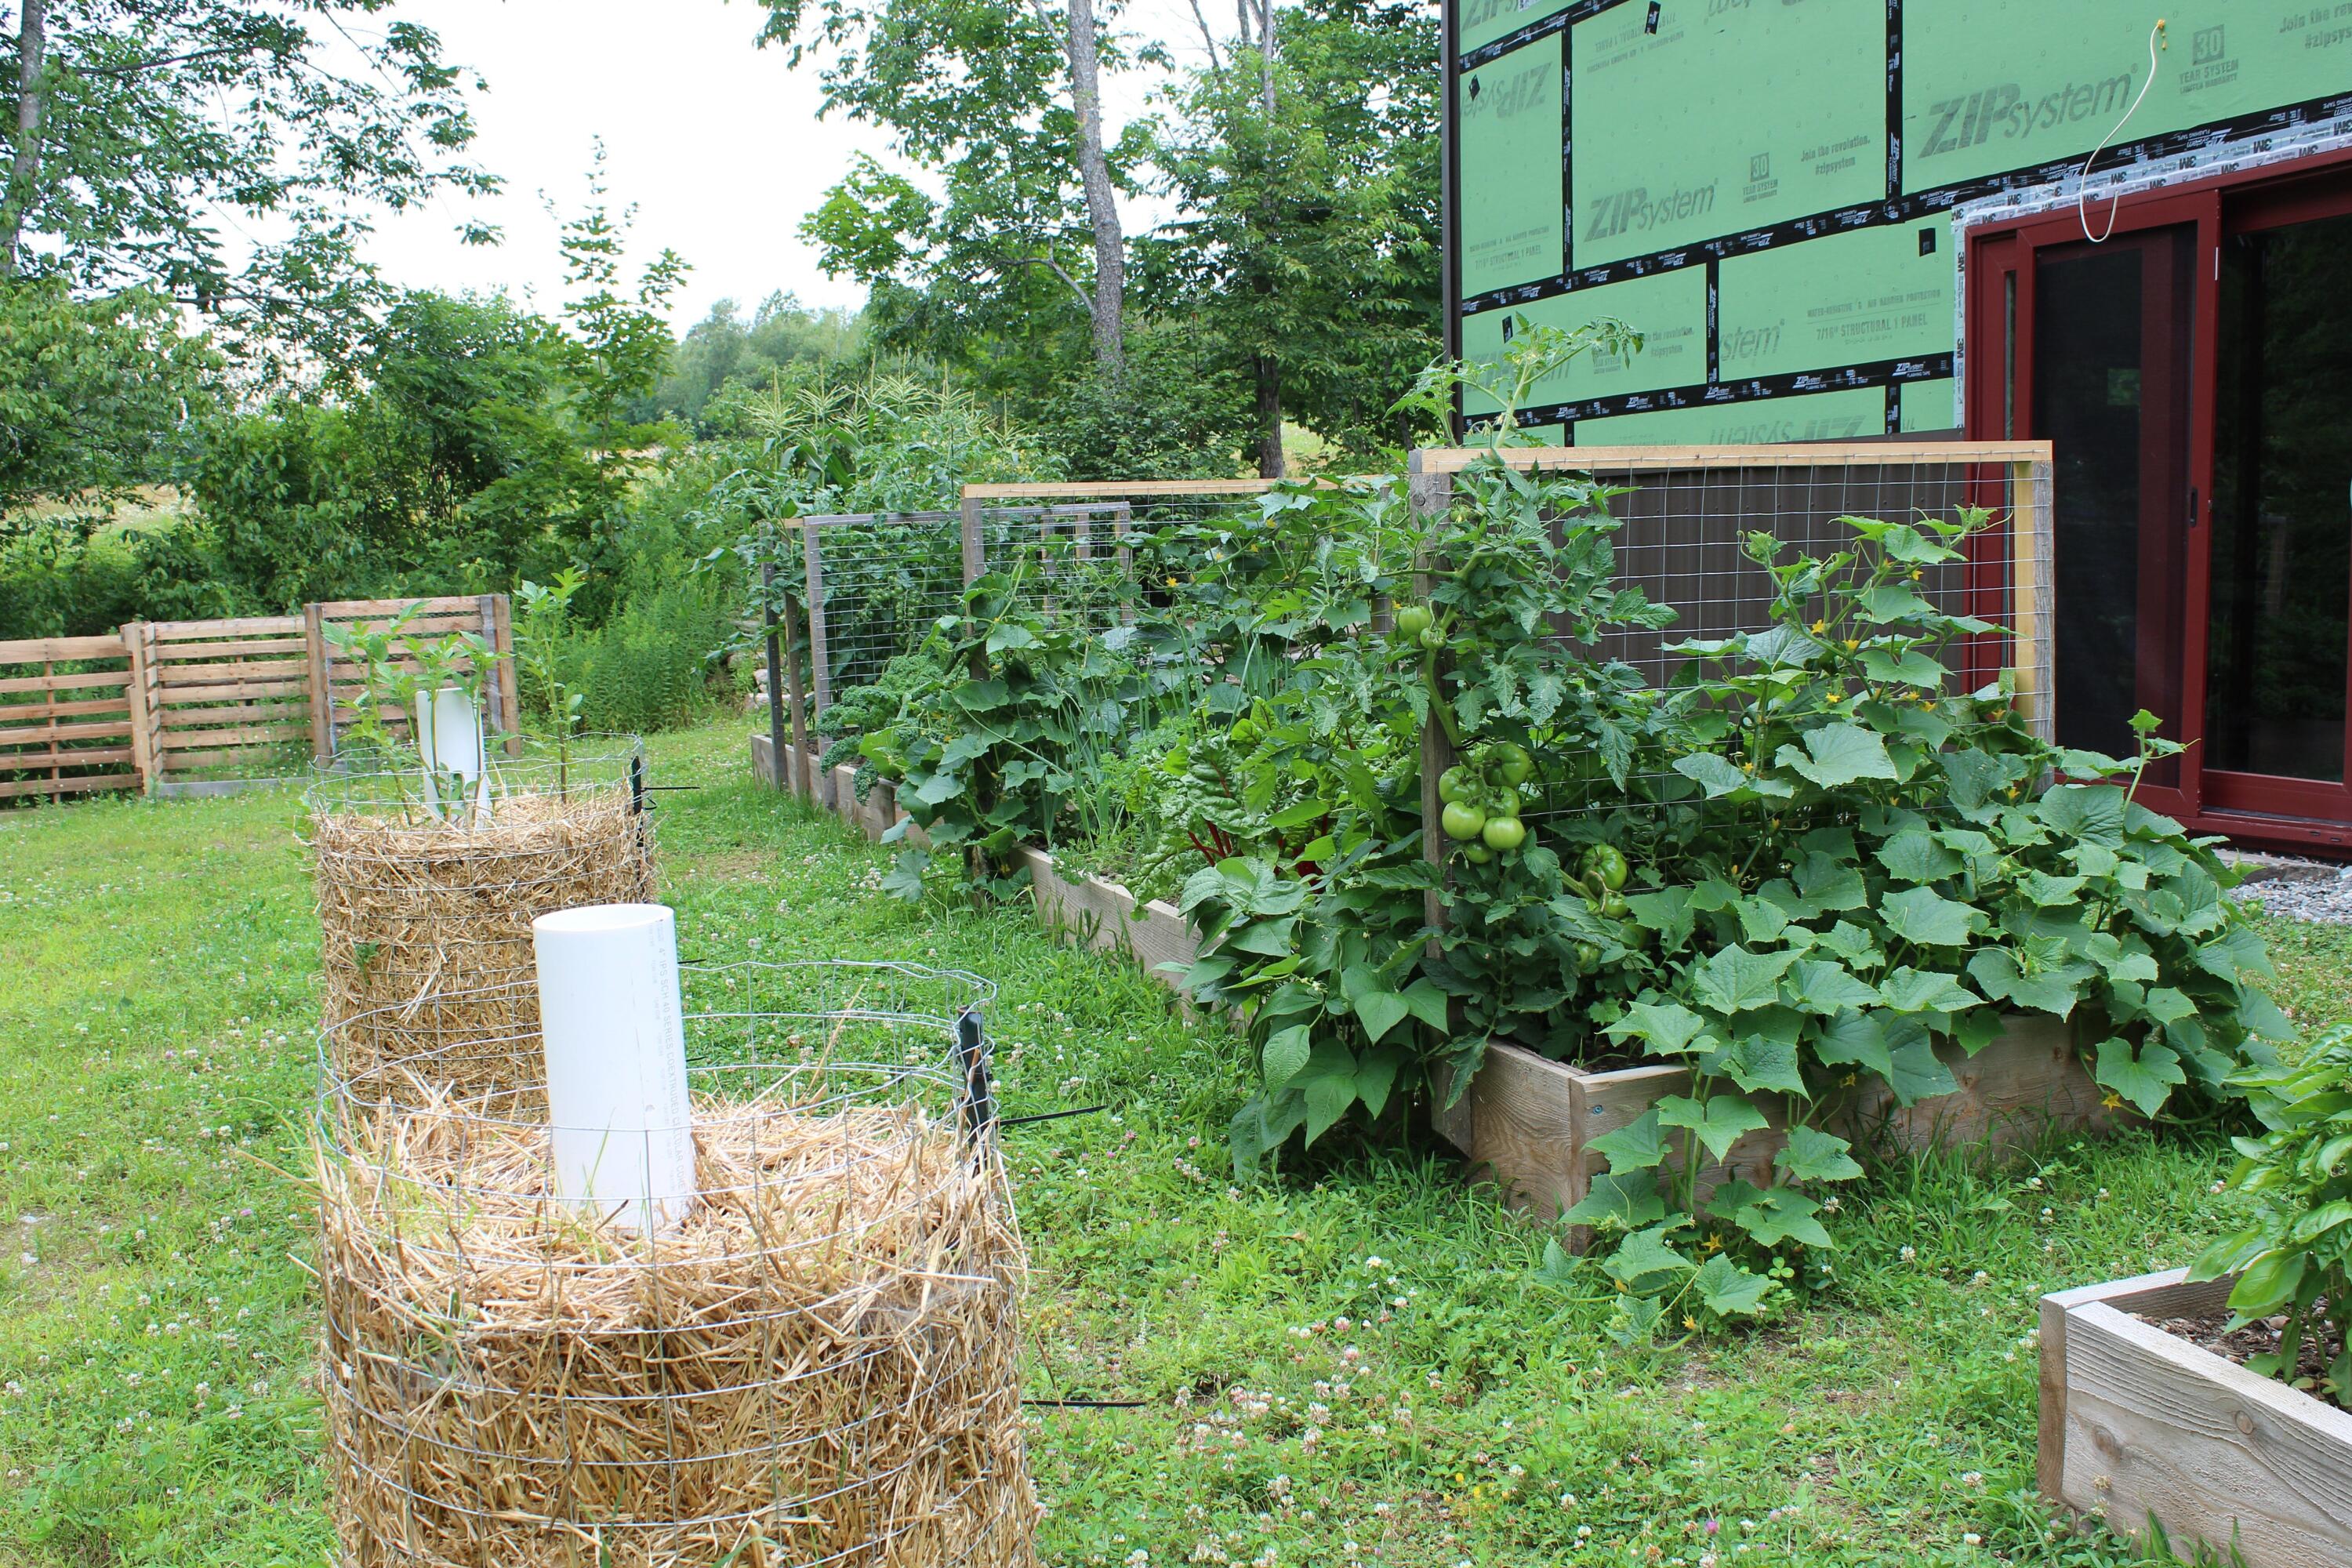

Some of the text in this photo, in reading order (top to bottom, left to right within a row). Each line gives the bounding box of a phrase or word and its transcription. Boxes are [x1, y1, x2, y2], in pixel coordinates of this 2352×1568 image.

[2279, 13, 2306, 33] Join
[2310, 8, 2330, 24] the
[2194, 27, 2223, 62] 30
[2180, 59, 2239, 84] YEAR SYSTEM
[1801, 135, 1871, 162] Join the revolution.
[2253, 138, 2273, 154] 3M
[2299, 144, 2318, 157] 3M
[1751, 155, 1769, 180] 30
[1815, 157, 1856, 176] #zipsystem
[2179, 156, 2197, 169] 3M
[2221, 162, 2239, 174] 3M
[1757, 179, 1778, 192] SYSTEM
[2111, 171, 2127, 185] 3M
[2007, 194, 2022, 205] 3M
[1957, 251, 1965, 272] 3M
[1841, 318, 1891, 336] STRUCTURAL
[1901, 313, 1928, 328] PANEL
[659, 960, 668, 977] IPS
[660, 978, 670, 999] SCH
[662, 1002, 671, 1012] 40
[664, 1014, 674, 1051] SERIES
[666, 1051, 680, 1115] COEXTRUDED
